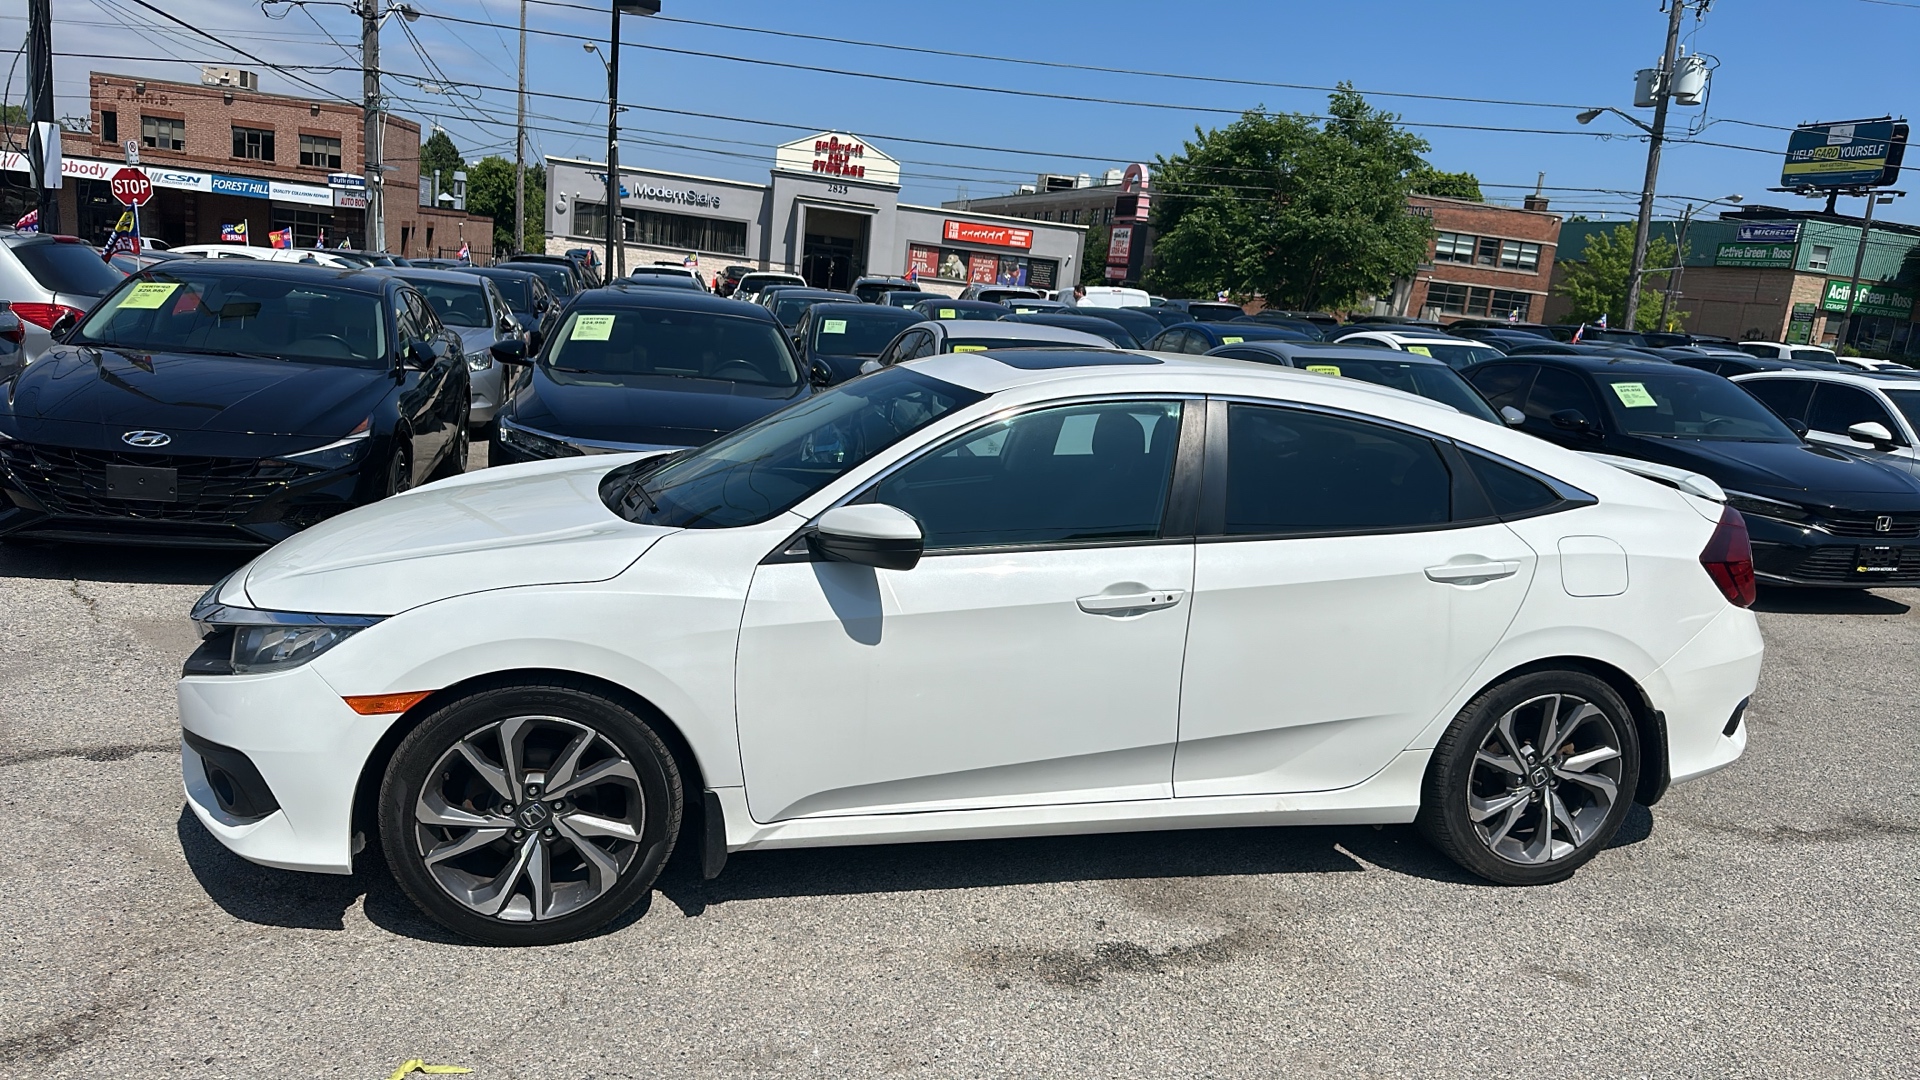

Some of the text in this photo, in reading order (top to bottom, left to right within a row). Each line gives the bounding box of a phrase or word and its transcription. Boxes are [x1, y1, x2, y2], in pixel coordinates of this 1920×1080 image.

[1792, 144, 1885, 160] HELP GARD YOURSELF
[61, 160, 109, 179] obody
[812, 160, 865, 178] STORAGE
[164, 173, 202, 184] CSN
[114, 179, 149, 195] STOP
[212, 179, 269, 195] FOREST HILL
[828, 184, 848, 195] 2825
[291, 190, 313, 198] COLLISION
[341, 197, 365, 207] AUTO BOD
[949, 222, 960, 230] FUR
[912, 246, 928, 258] FUR
[1719, 246, 1744, 257] Active
[1825, 303, 1856, 313] COMPLE
[1873, 308, 1887, 316] AUTO
